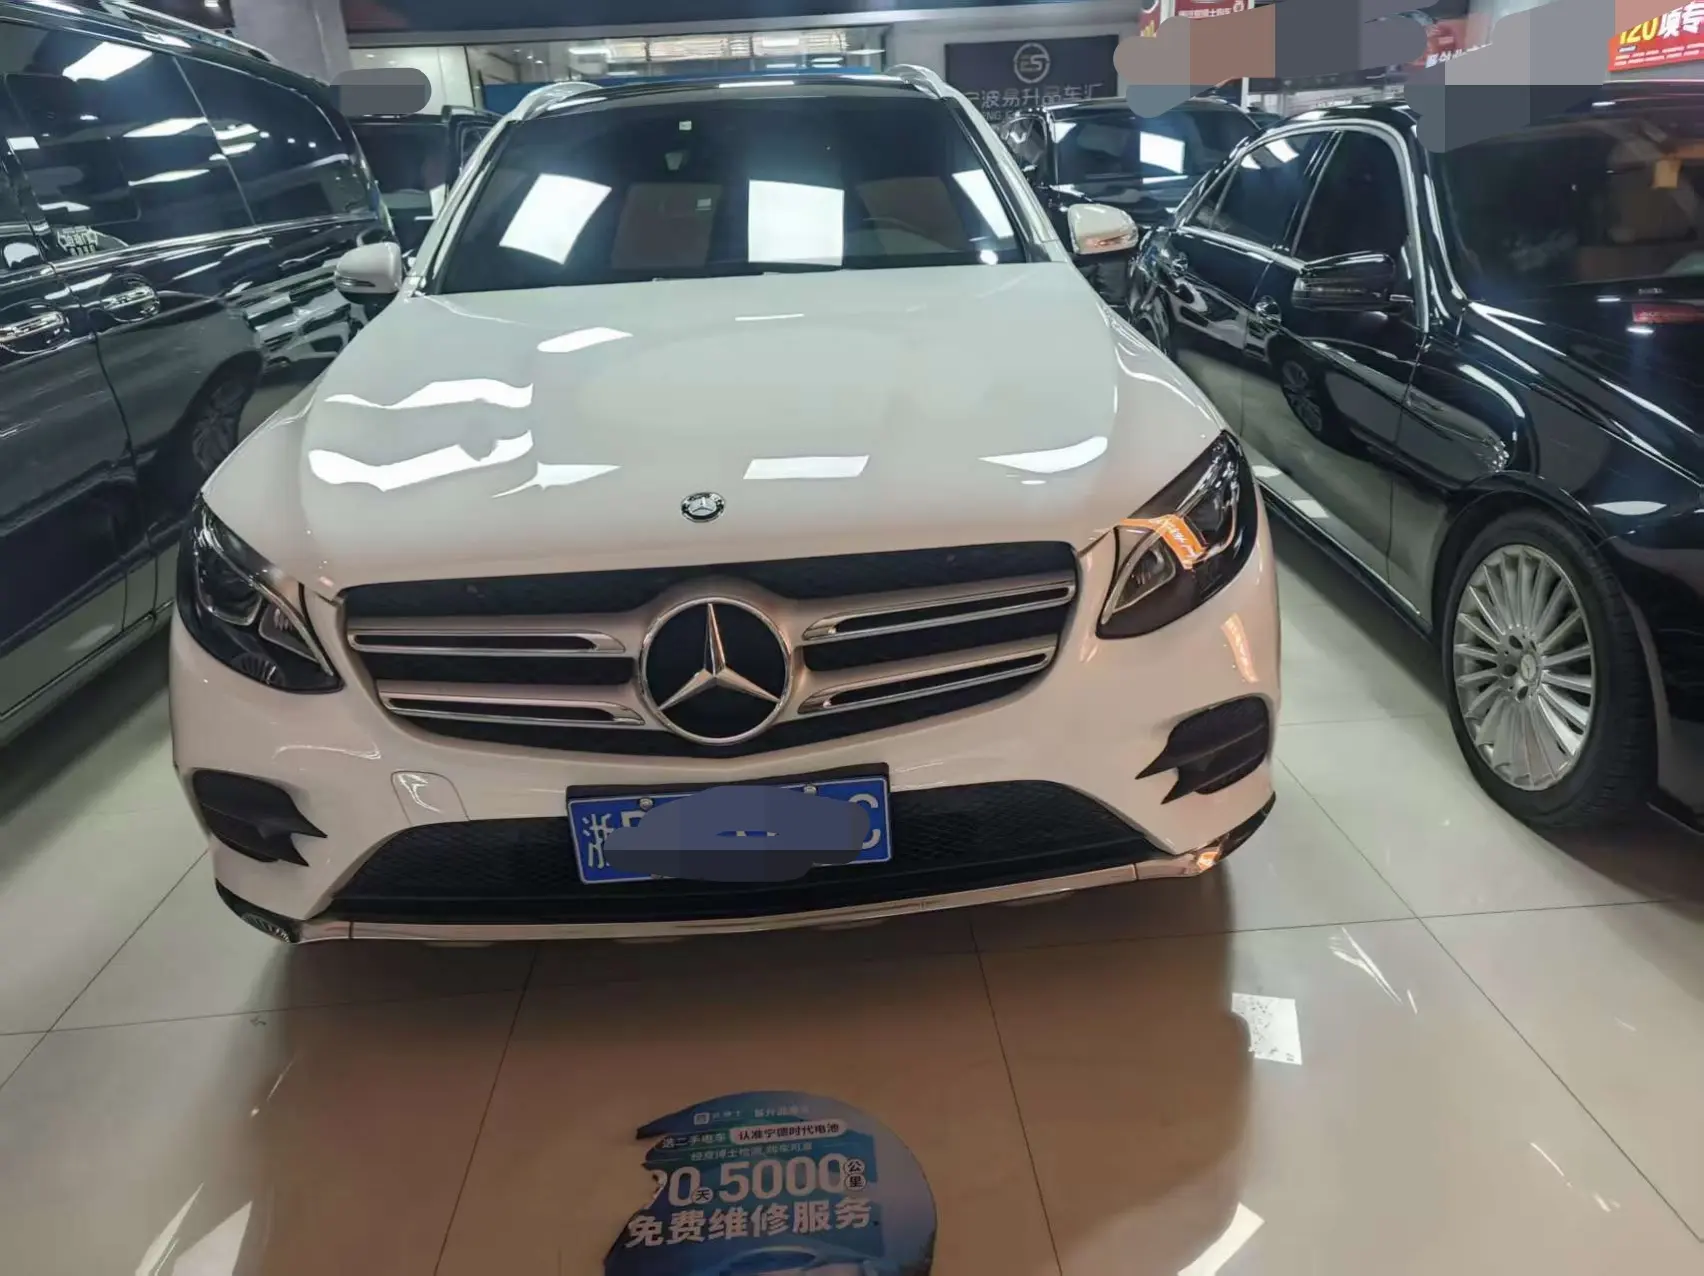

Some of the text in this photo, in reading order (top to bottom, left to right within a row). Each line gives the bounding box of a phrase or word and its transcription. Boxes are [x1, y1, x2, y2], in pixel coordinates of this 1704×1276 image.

[738, 1122, 840, 1141] 认准宁德时代电池
[624, 1194, 872, 1249] 免费维修服务
